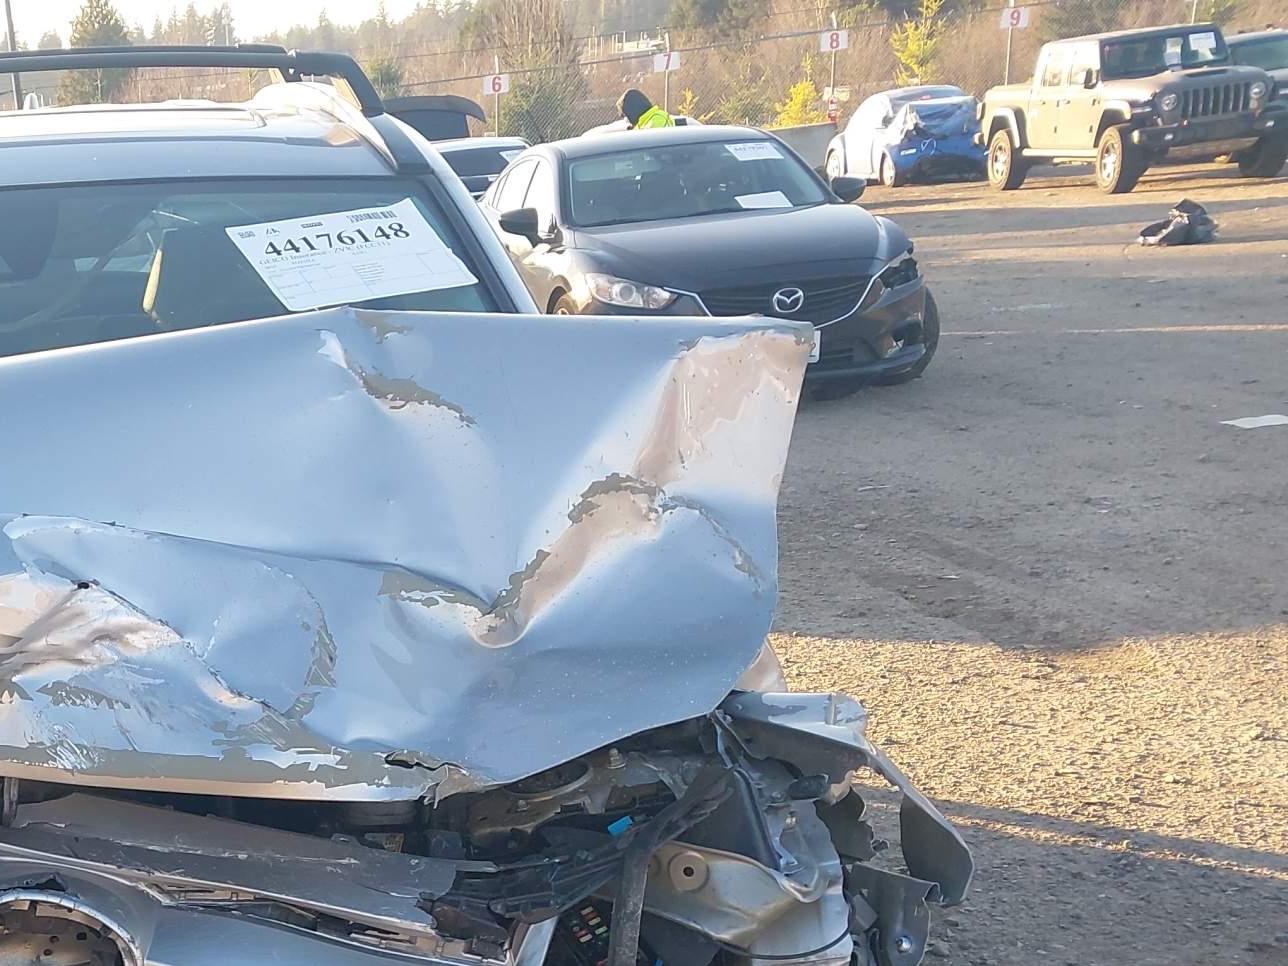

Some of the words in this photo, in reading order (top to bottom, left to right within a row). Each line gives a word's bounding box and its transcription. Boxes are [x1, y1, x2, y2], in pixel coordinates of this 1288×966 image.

[1010, 9, 1021, 25] 9
[829, 32, 840, 49] 8
[663, 53, 672, 70] 7
[491, 76, 502, 93] 6
[264, 222, 410, 256] 44176148
